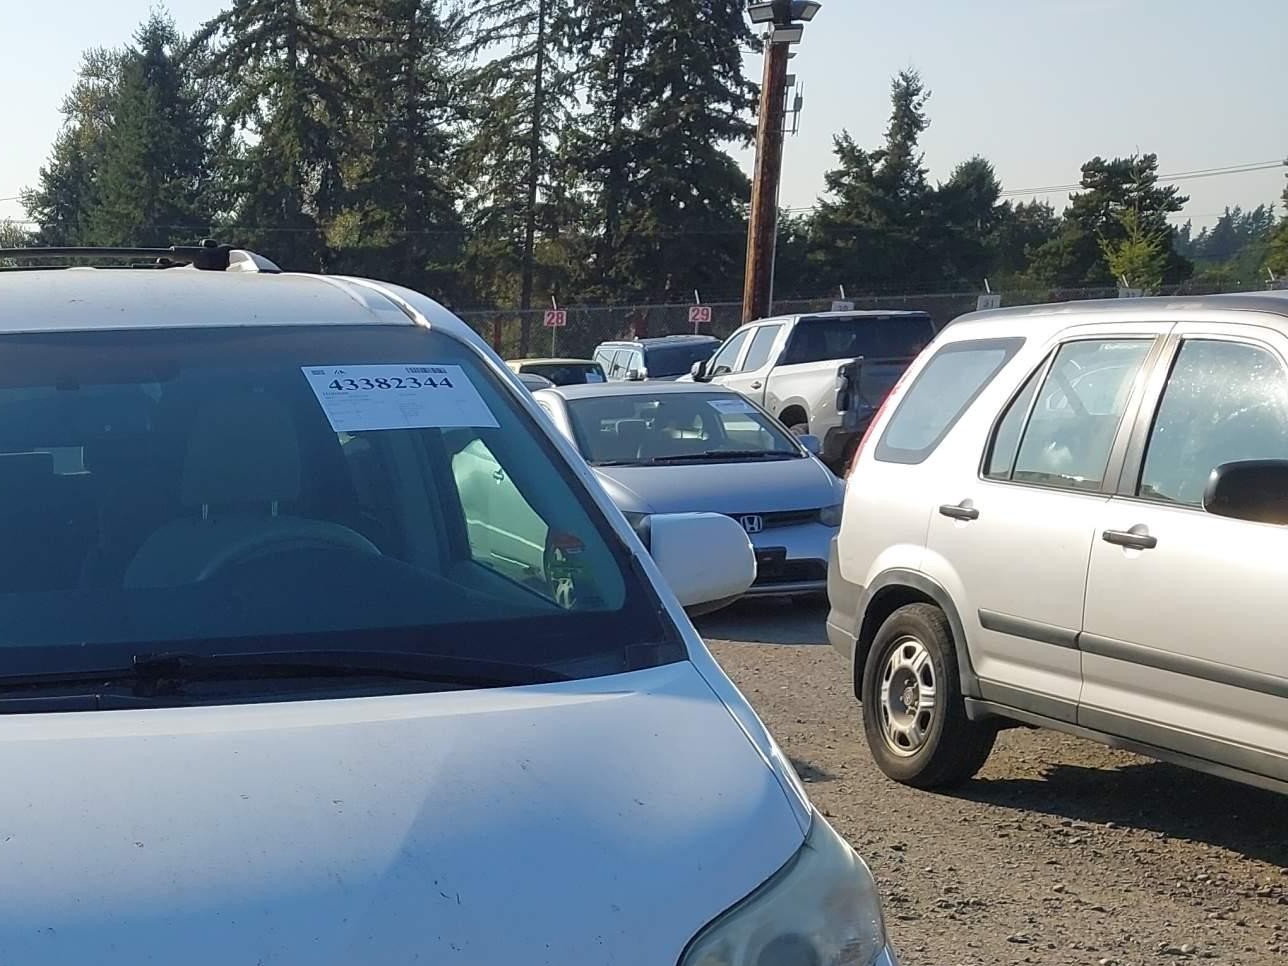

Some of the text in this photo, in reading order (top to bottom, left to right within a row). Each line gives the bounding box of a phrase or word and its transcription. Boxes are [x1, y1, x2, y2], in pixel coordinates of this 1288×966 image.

[546, 312, 564, 325] 28
[692, 308, 710, 321] 29
[328, 377, 454, 391] 43382344
